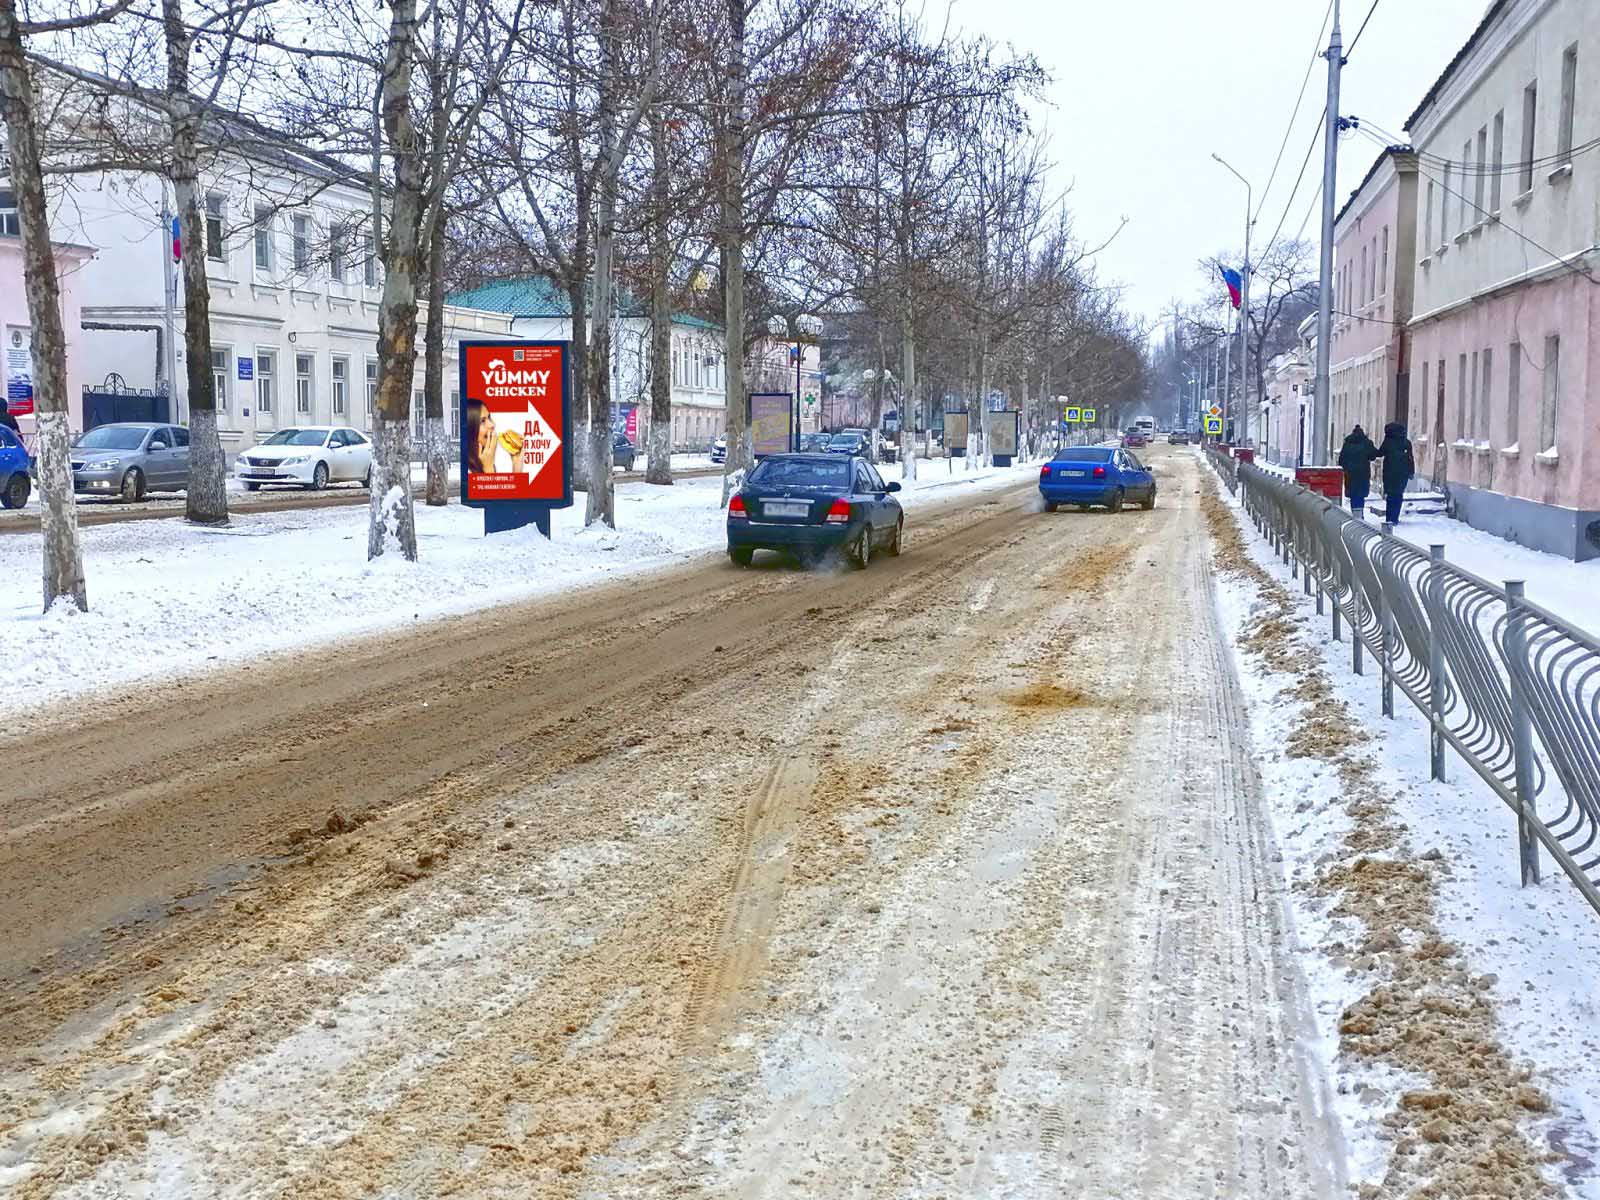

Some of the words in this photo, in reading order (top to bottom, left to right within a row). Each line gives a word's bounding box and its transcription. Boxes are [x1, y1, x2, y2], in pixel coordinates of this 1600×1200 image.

[485, 386, 546, 397] CHICKEN
[524, 420, 544, 437] ДА,
[523, 439, 529, 449] Я
[531, 439, 551, 449] ХОЧУ
[524, 451, 544, 464] ЭТО!
